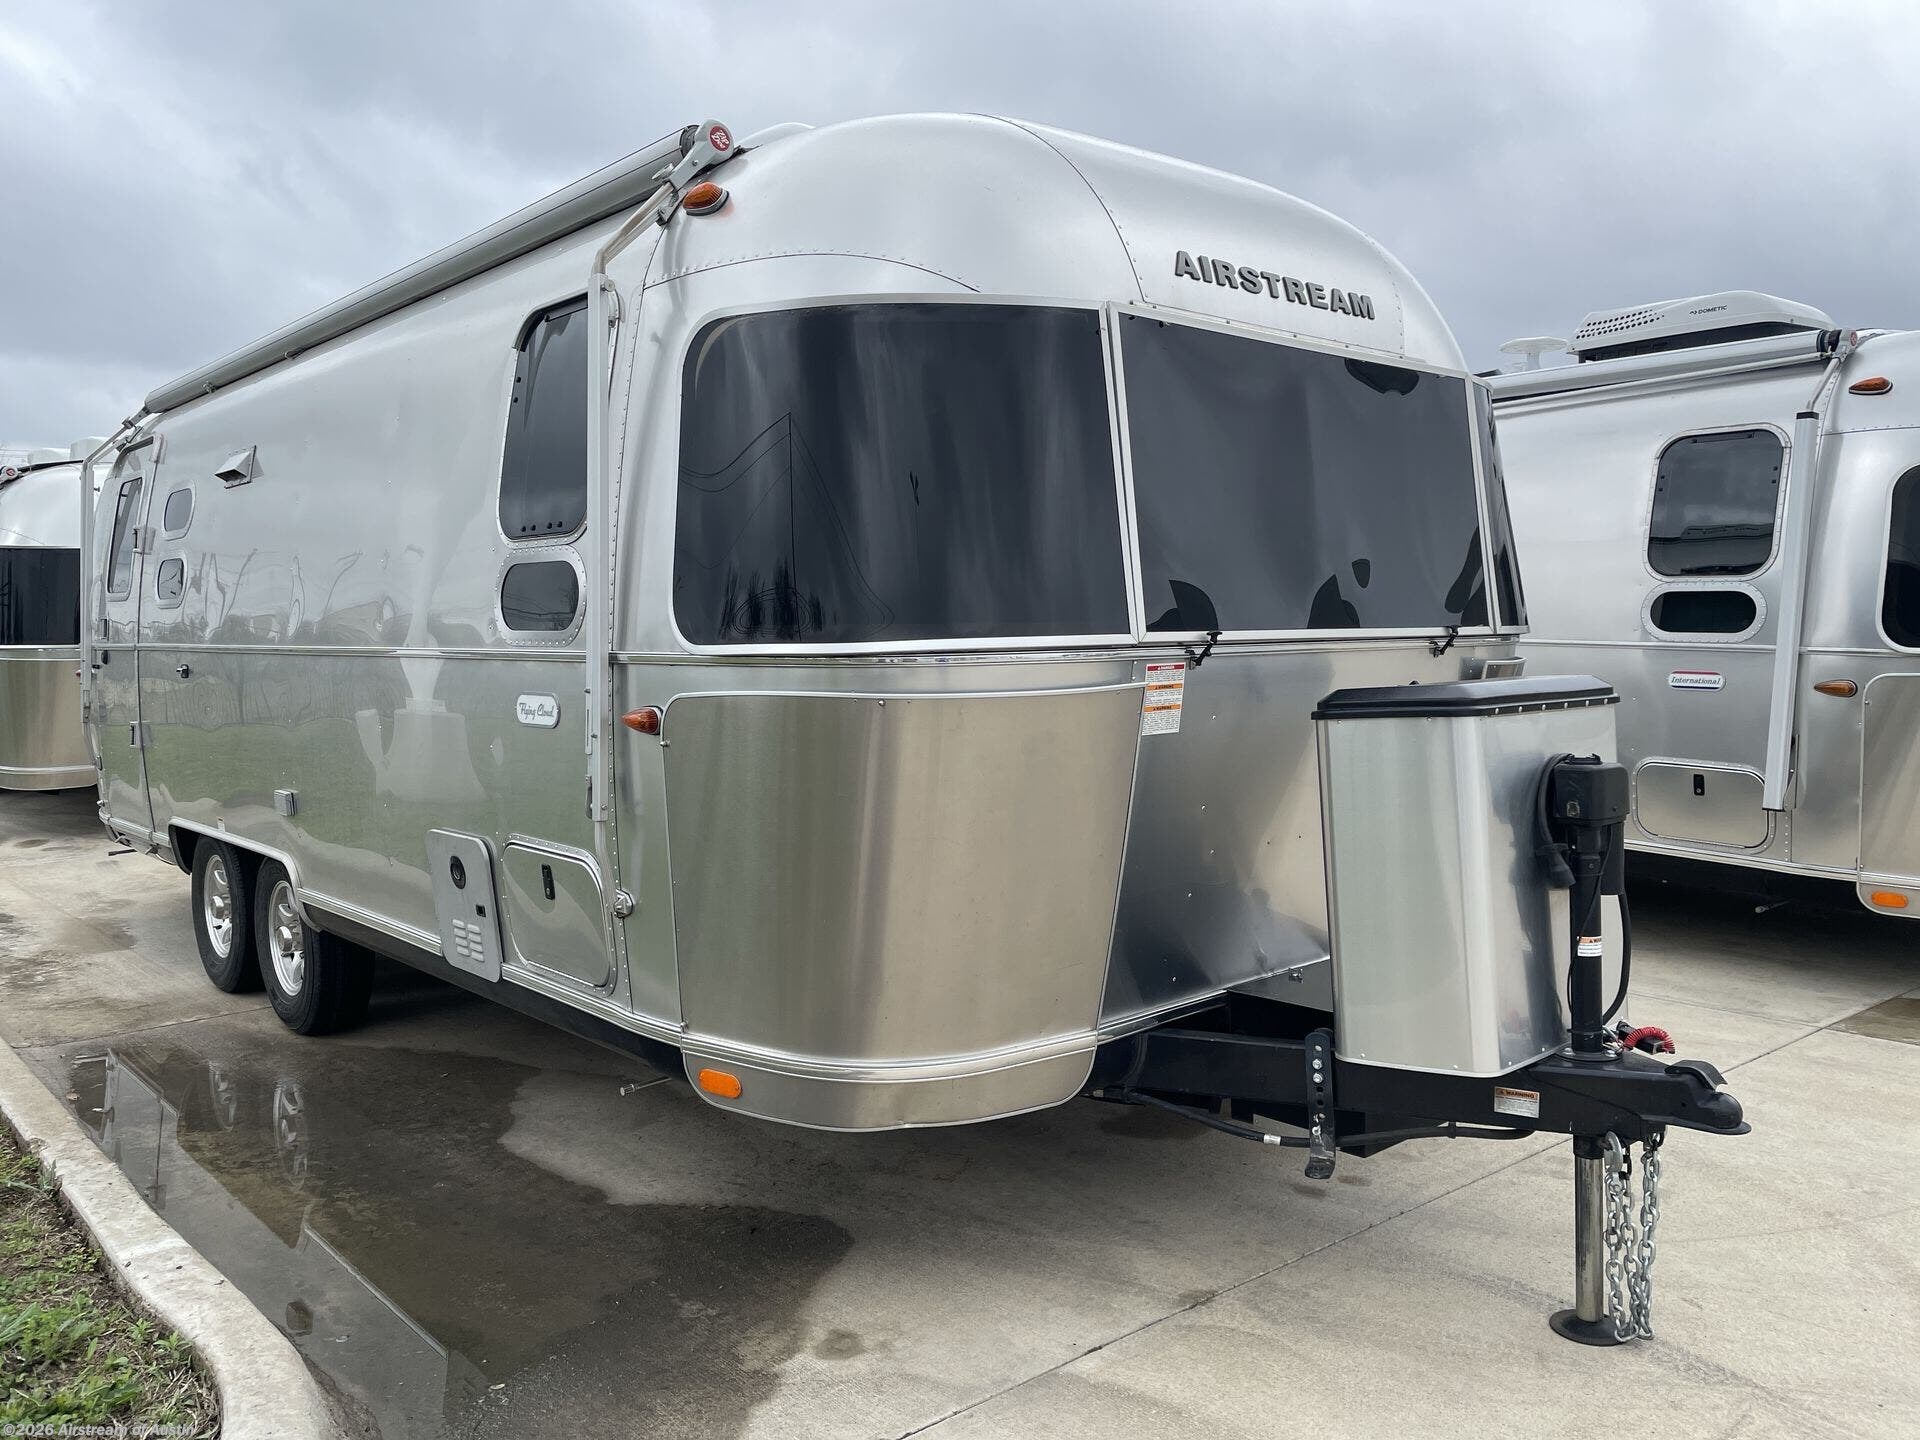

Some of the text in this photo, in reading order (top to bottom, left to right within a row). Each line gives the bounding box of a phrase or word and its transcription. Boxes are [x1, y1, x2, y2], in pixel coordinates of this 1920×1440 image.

[1175, 250, 1375, 320] AIRSTREAM
[1698, 304, 1727, 314] DOMETIC
[1671, 676, 1721, 685] International
[519, 702, 555, 720] Flying Cloud
[1506, 1090, 1535, 1099] WARNING
